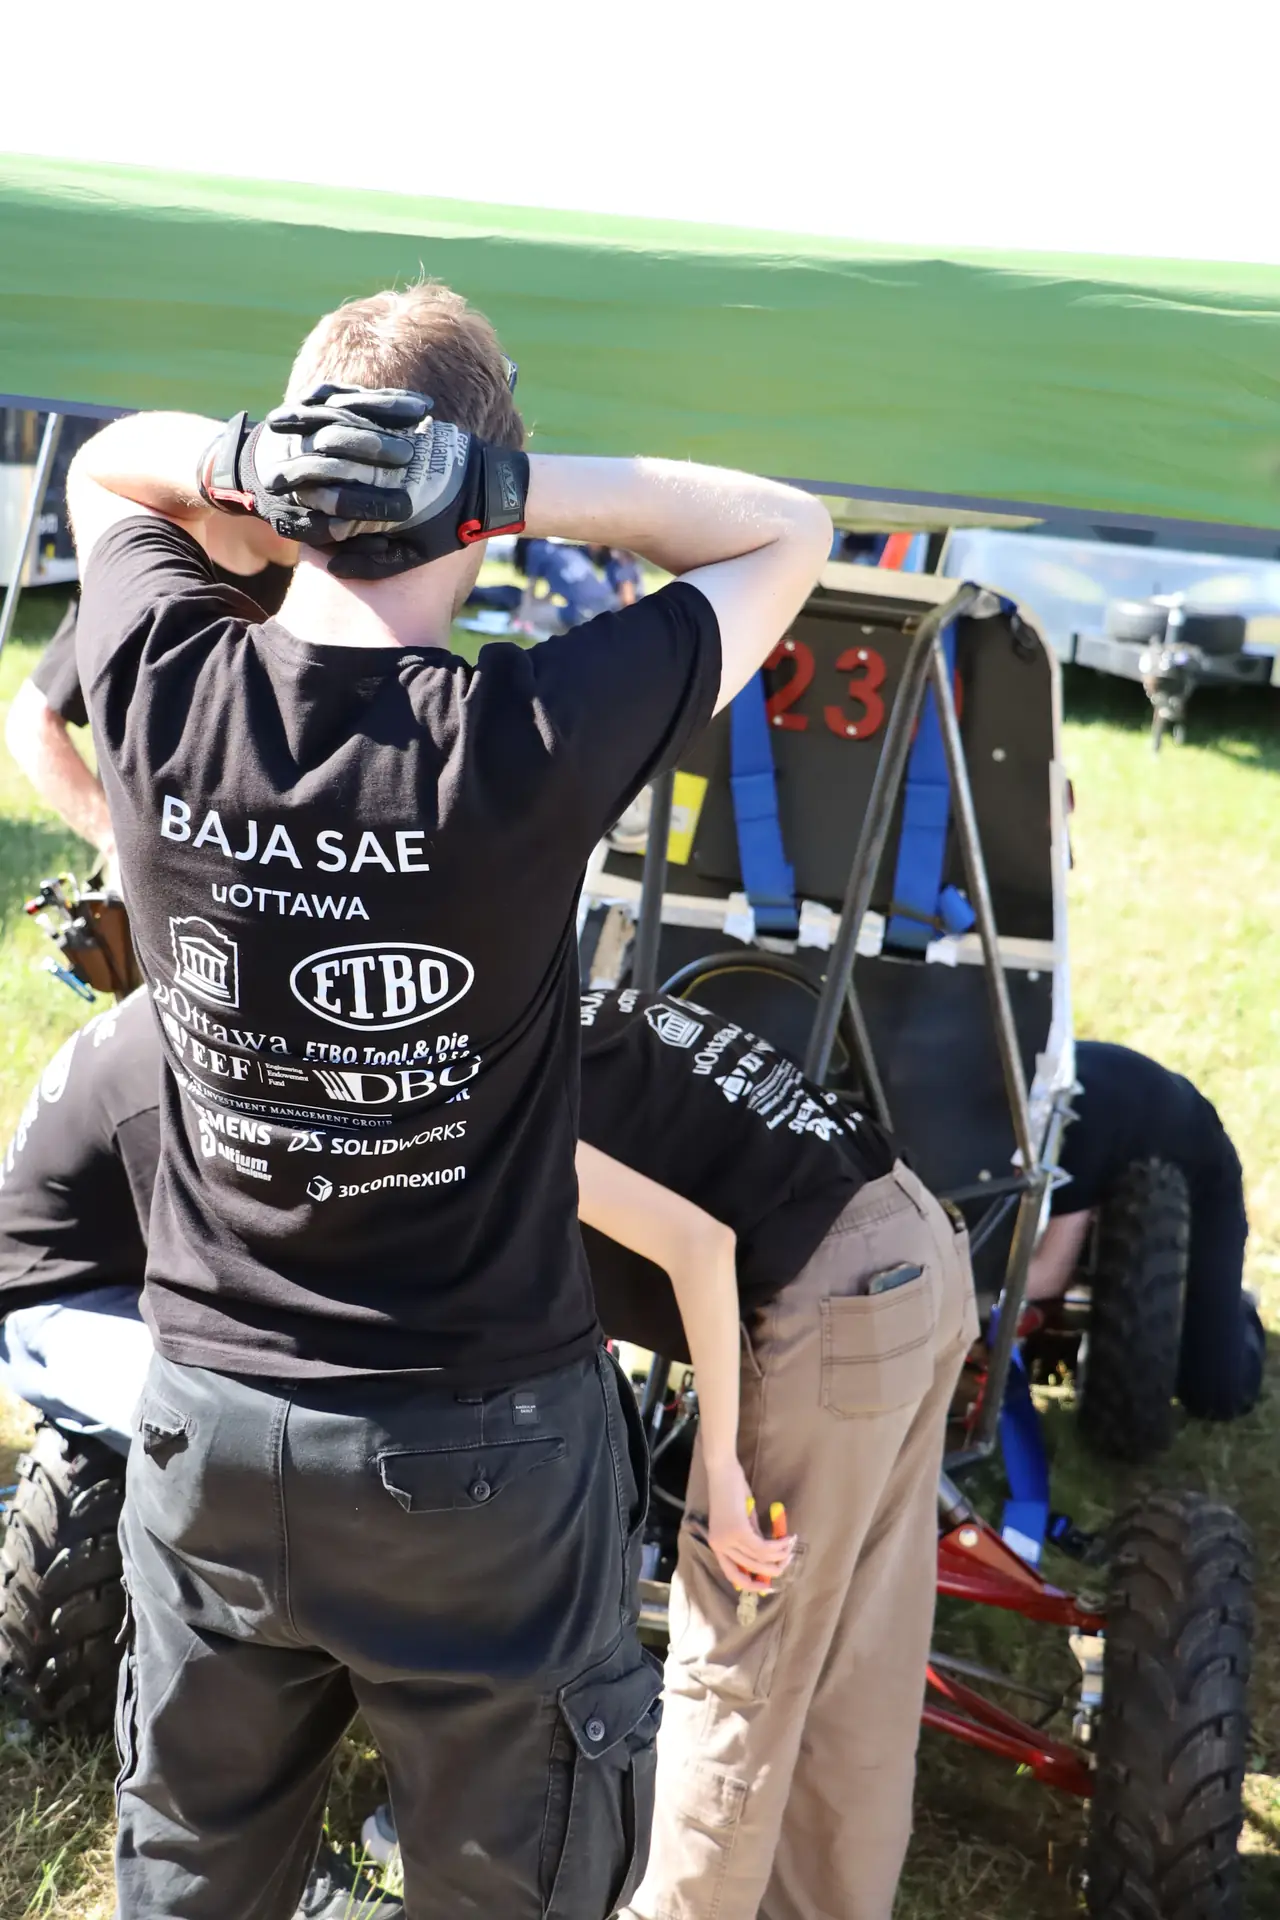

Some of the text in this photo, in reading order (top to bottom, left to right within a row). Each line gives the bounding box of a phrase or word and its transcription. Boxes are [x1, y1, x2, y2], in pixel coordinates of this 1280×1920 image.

[402, 424, 431, 485] echanix
[763, 641, 964, 741] 23
[160, 794, 430, 873] BAJA SAE
[211, 882, 370, 921] uOTTAWA
[153, 978, 292, 1056] uOttawa
[311, 954, 449, 1020] ETBO
[306, 1041, 358, 1064] ETBO
[363, 1042, 409, 1065] Tool
[413, 1039, 429, 1060] &
[436, 1032, 469, 1054] Die
[202, 1086, 393, 1128] INVESTMENT MANAGEMENT GROUP
[330, 1120, 467, 1156] SOLIDWORKS
